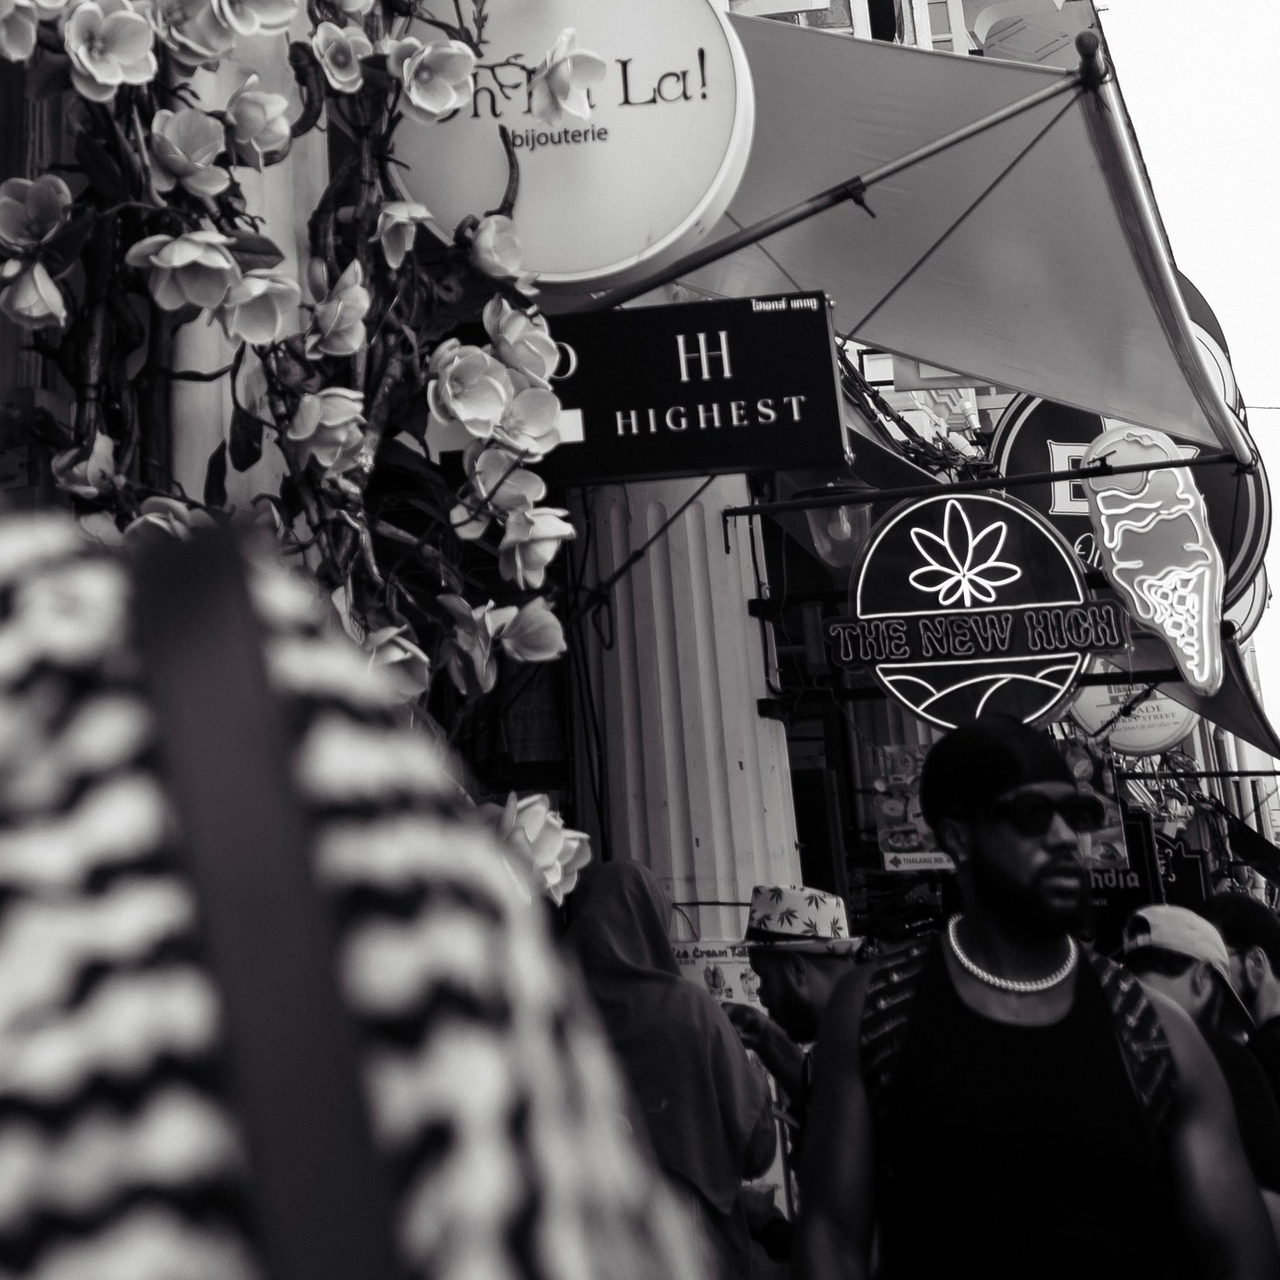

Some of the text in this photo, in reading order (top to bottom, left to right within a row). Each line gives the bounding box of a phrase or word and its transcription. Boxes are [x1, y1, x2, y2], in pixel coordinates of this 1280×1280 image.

[614, 46, 708, 107] La!
[511, 123, 609, 152] bijouterie
[615, 395, 807, 435] HIGHEST
[829, 605, 1120, 661] THE NEW HIGH
